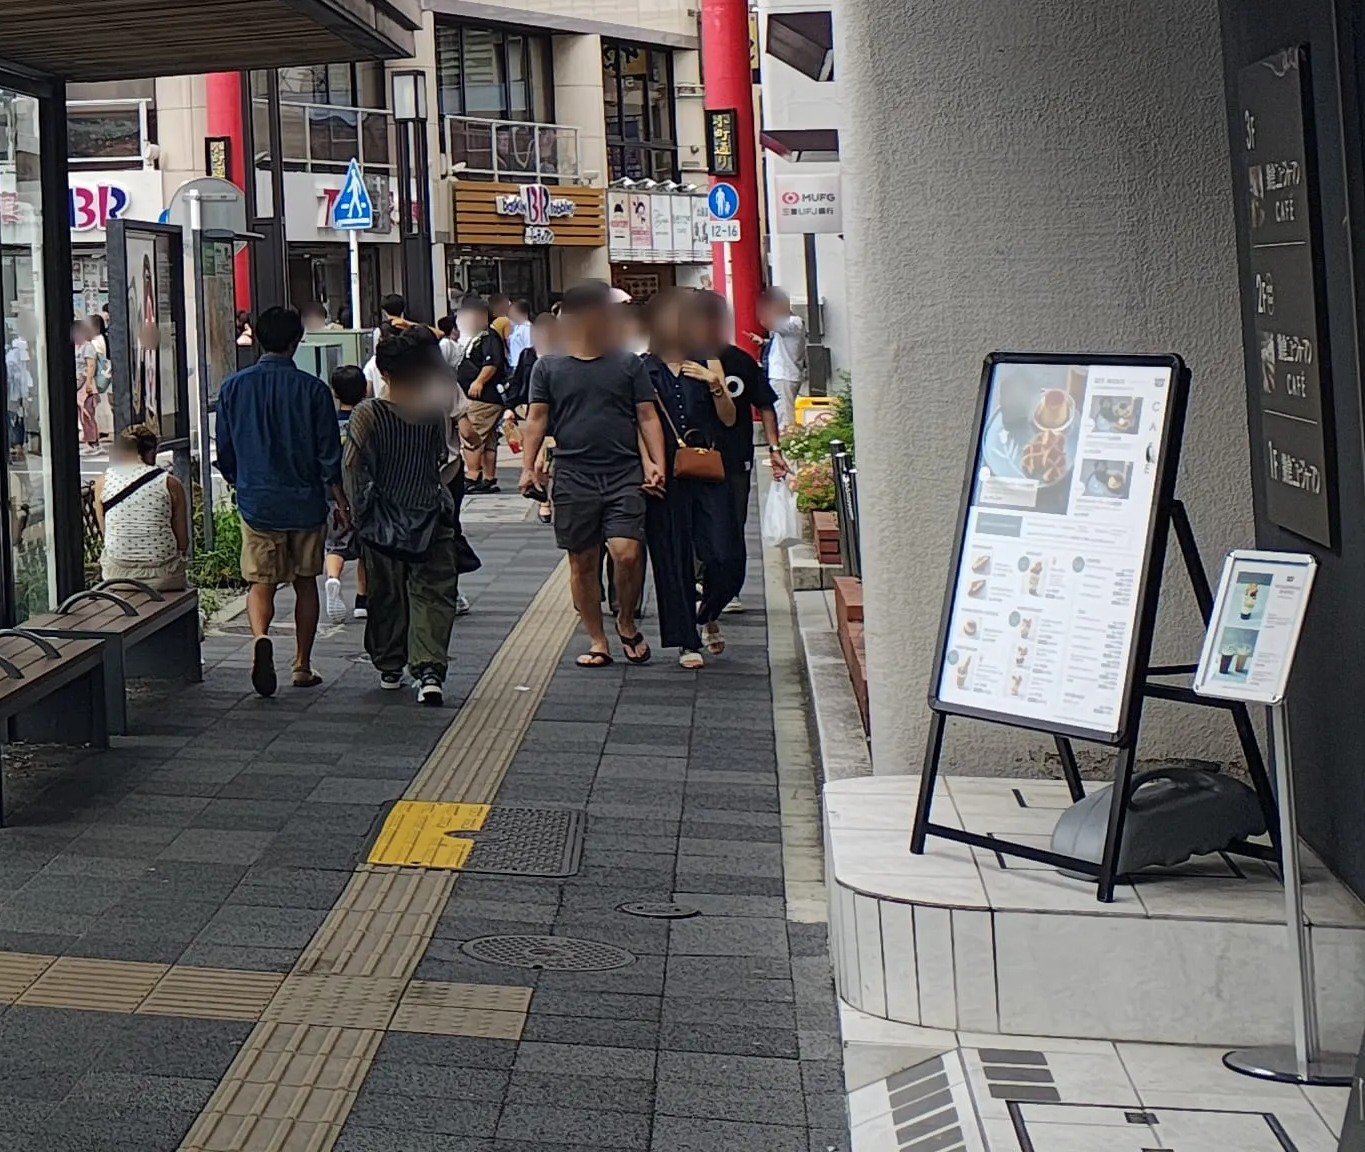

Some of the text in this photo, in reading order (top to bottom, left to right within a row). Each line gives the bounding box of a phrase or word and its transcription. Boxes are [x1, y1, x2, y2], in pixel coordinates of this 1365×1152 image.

[712, 114, 732, 171] 小町通り
[526, 186, 549, 223] BR
[802, 193, 836, 203] MUFG
[1275, 193, 1295, 223] CAFÉ
[782, 207, 835, 217] 三菱UFJ銀行
[711, 225, 738, 236] 12-16
[1286, 371, 1307, 398] CAFÉ
